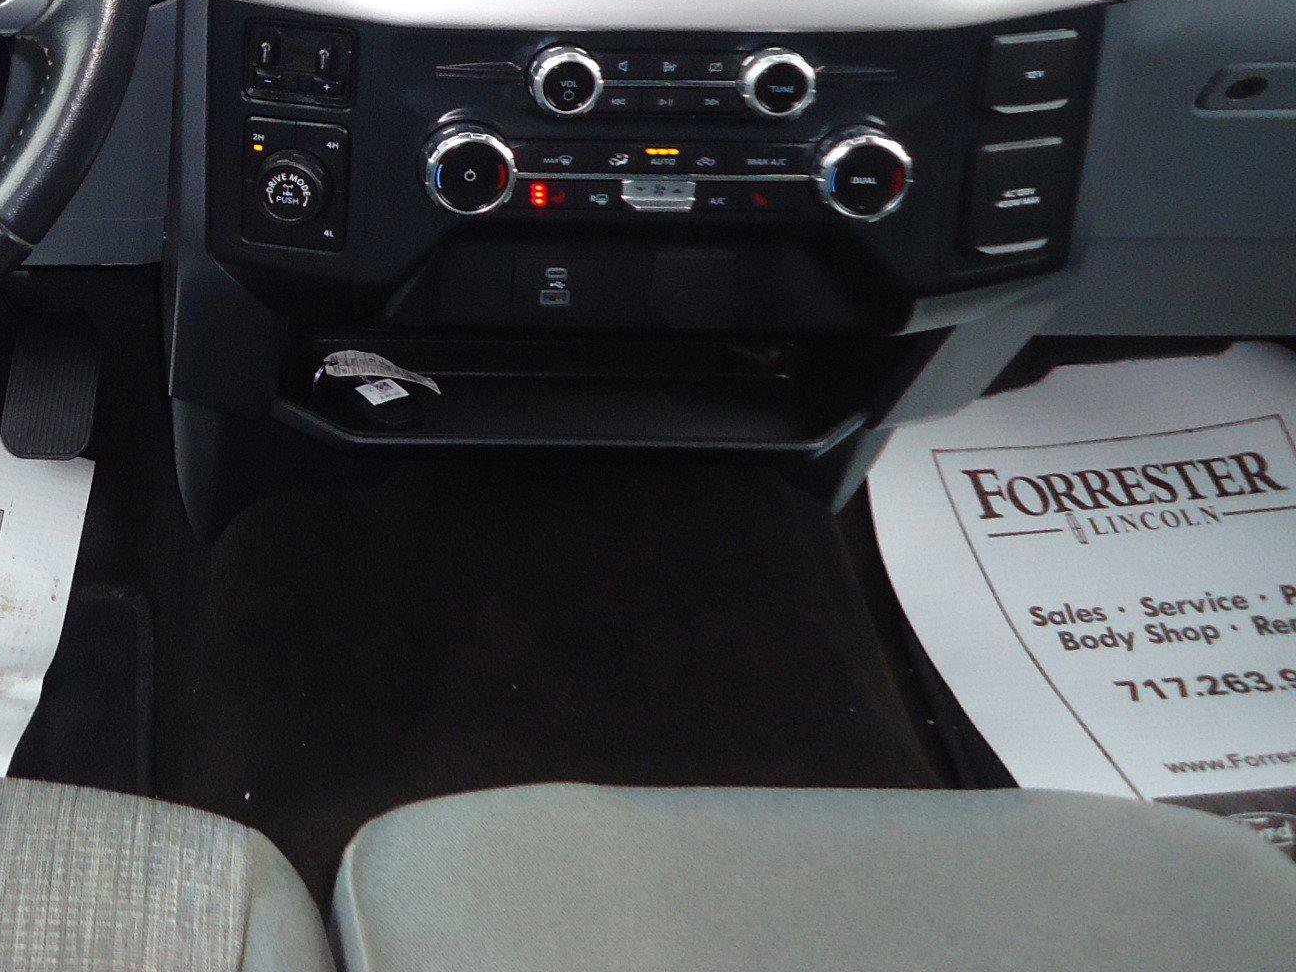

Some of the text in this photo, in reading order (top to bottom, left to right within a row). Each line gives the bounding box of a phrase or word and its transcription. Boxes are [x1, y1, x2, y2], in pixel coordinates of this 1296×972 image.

[560, 80, 578, 88] VOL
[252, 133, 265, 142] 2H
[325, 141, 339, 150] 4H
[651, 158, 676, 166] AUTO
[266, 173, 312, 197] DRIVE MODE
[849, 176, 877, 185] DUAL
[276, 195, 300, 205] PUSH
[709, 197, 726, 205] A/C
[323, 229, 335, 238] 4L
[961, 451, 1289, 520] FORRESTER
[1087, 506, 1225, 536] LINCOLN
[1029, 603, 1108, 627] Sales
[1139, 592, 1250, 618] Service
[1057, 628, 1134, 652] Body
[1147, 623, 1221, 645] Shop
